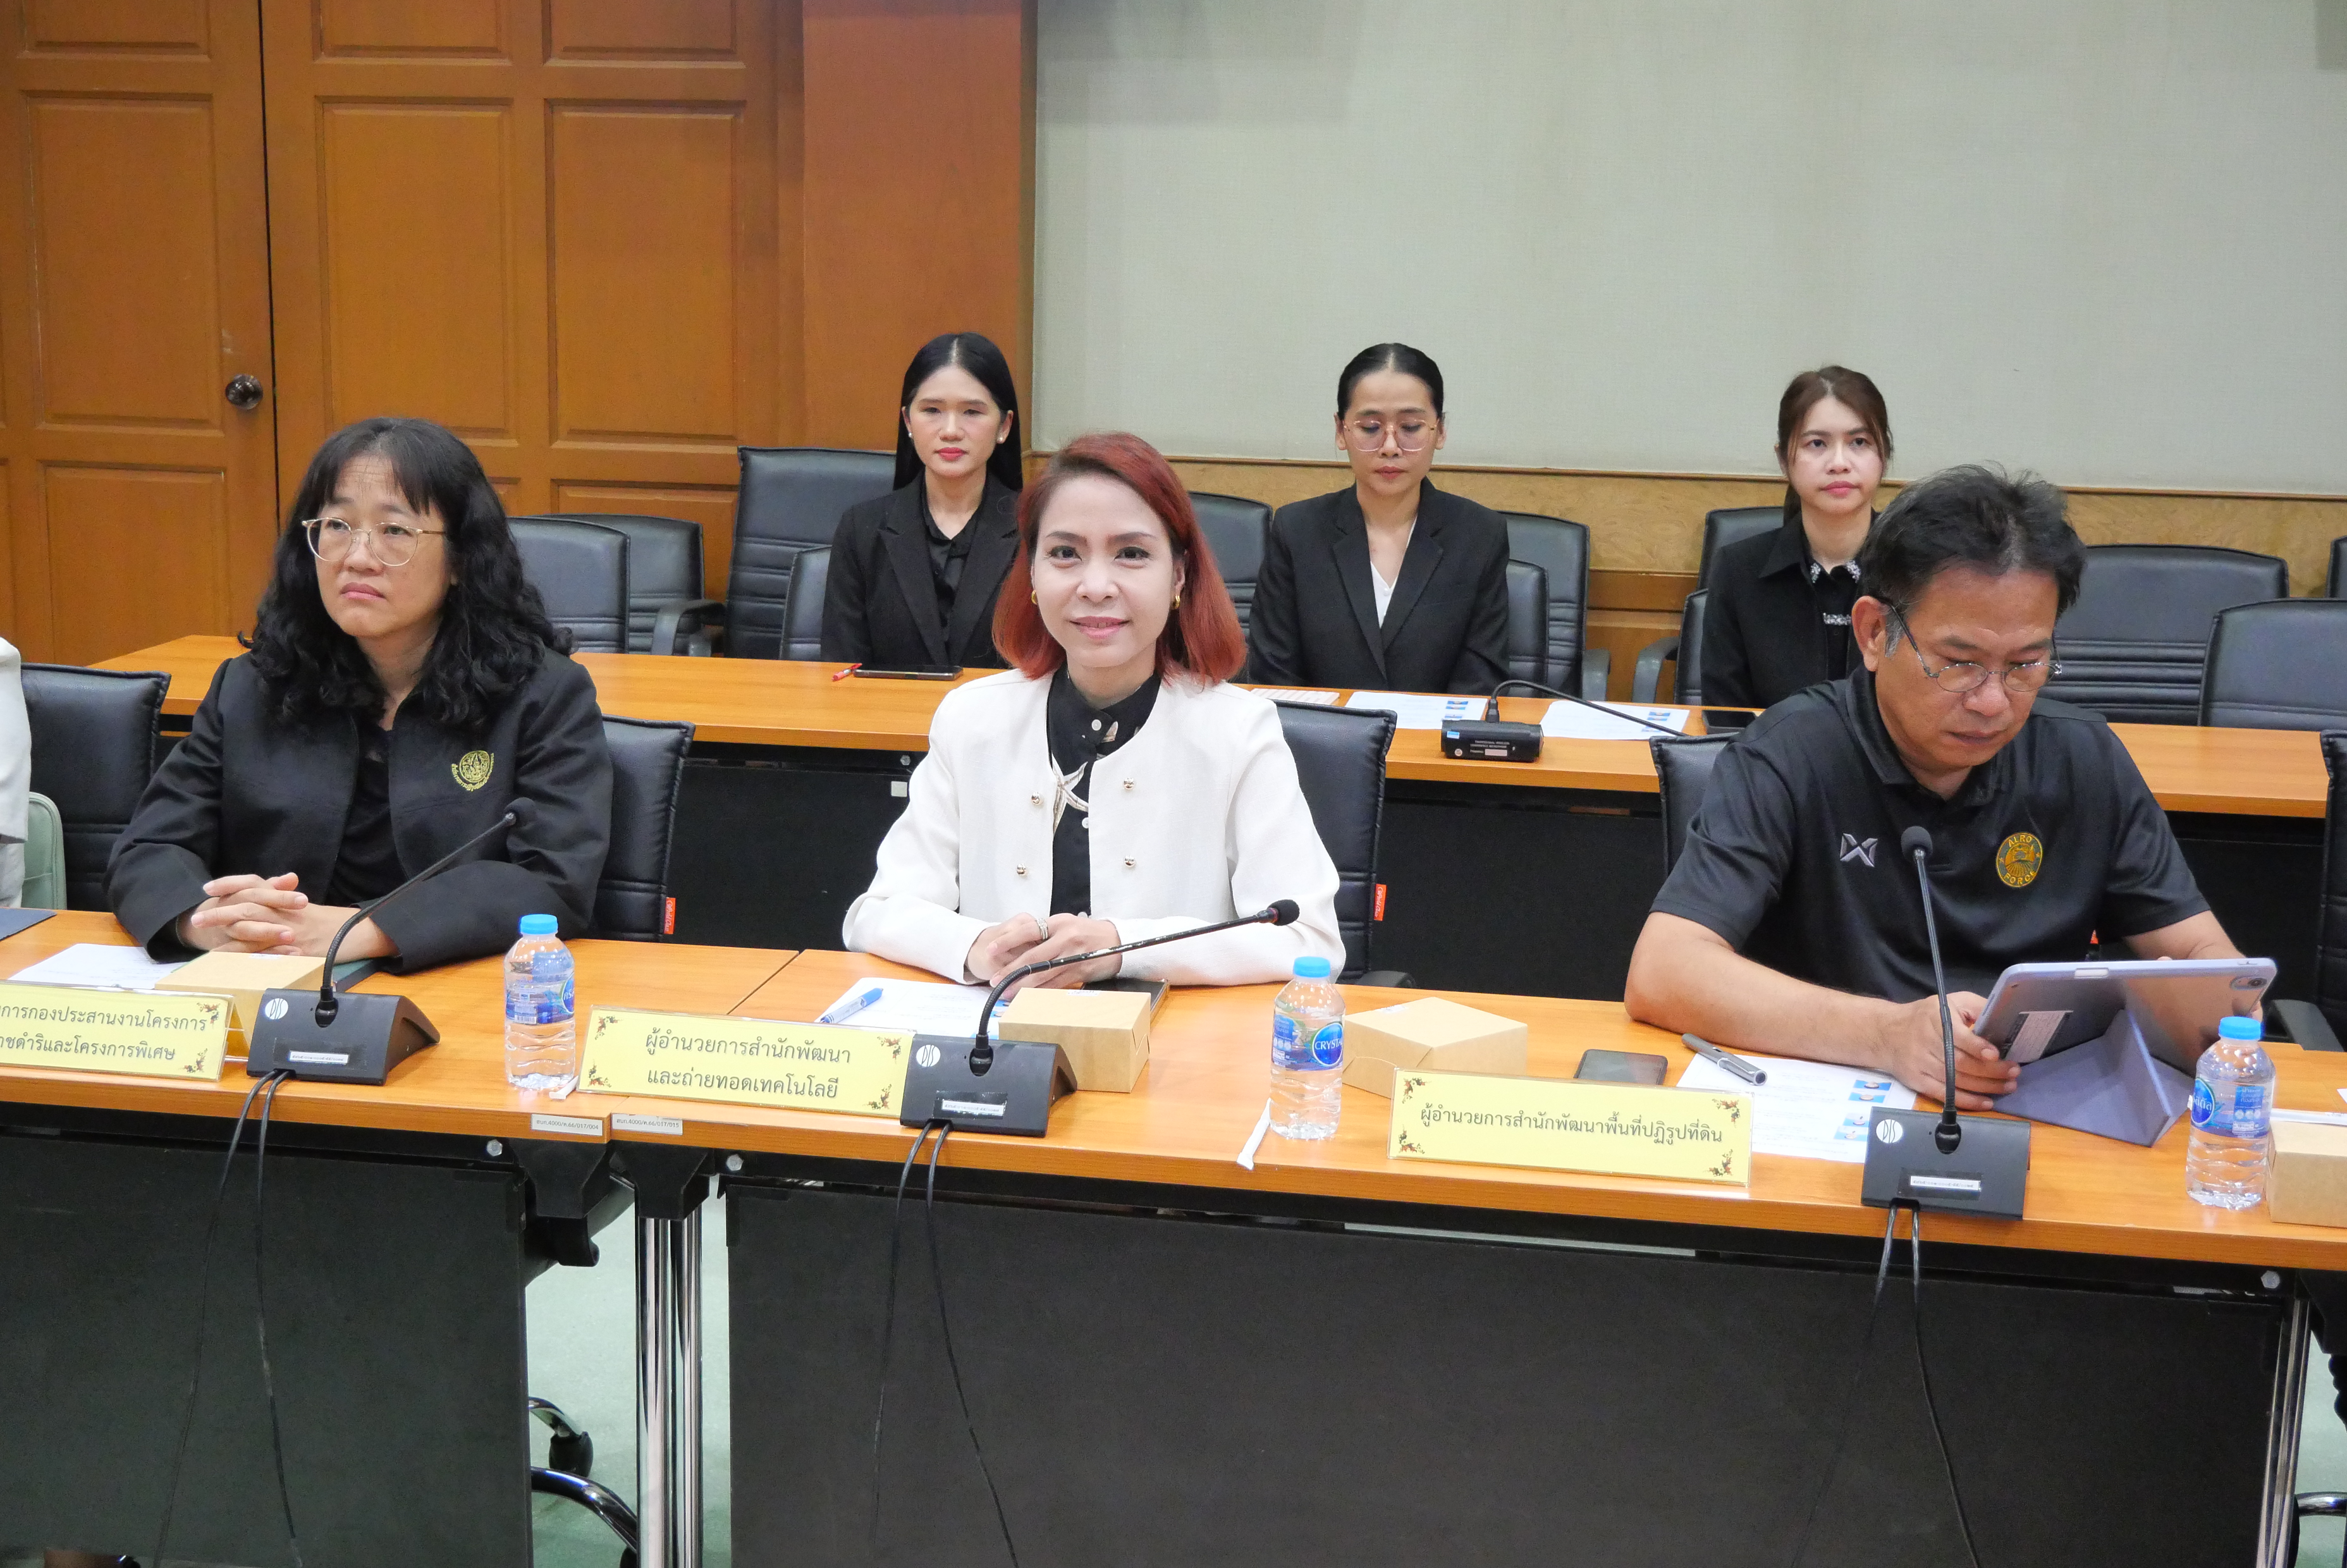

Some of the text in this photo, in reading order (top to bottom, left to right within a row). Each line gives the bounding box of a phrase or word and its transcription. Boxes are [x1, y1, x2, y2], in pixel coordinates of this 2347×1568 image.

[2009, 835, 2032, 847] ALRO
[2004, 871, 2037, 885] FORCE
[0, 1005, 207, 1032] การกองประสานงานโครงการ
[645, 1027, 851, 1063] ผู้อำนวยการสำนักพัฒนา
[1314, 1038, 1342, 1050] CRYSTA
[647, 1067, 839, 1099] และถ่ายทอดเทคโนโลยี
[1420, 1102, 1723, 1146] ผู้อำนวยการสำนักพัฒนาพื้นที่ปฏิรูปที่ดิน
